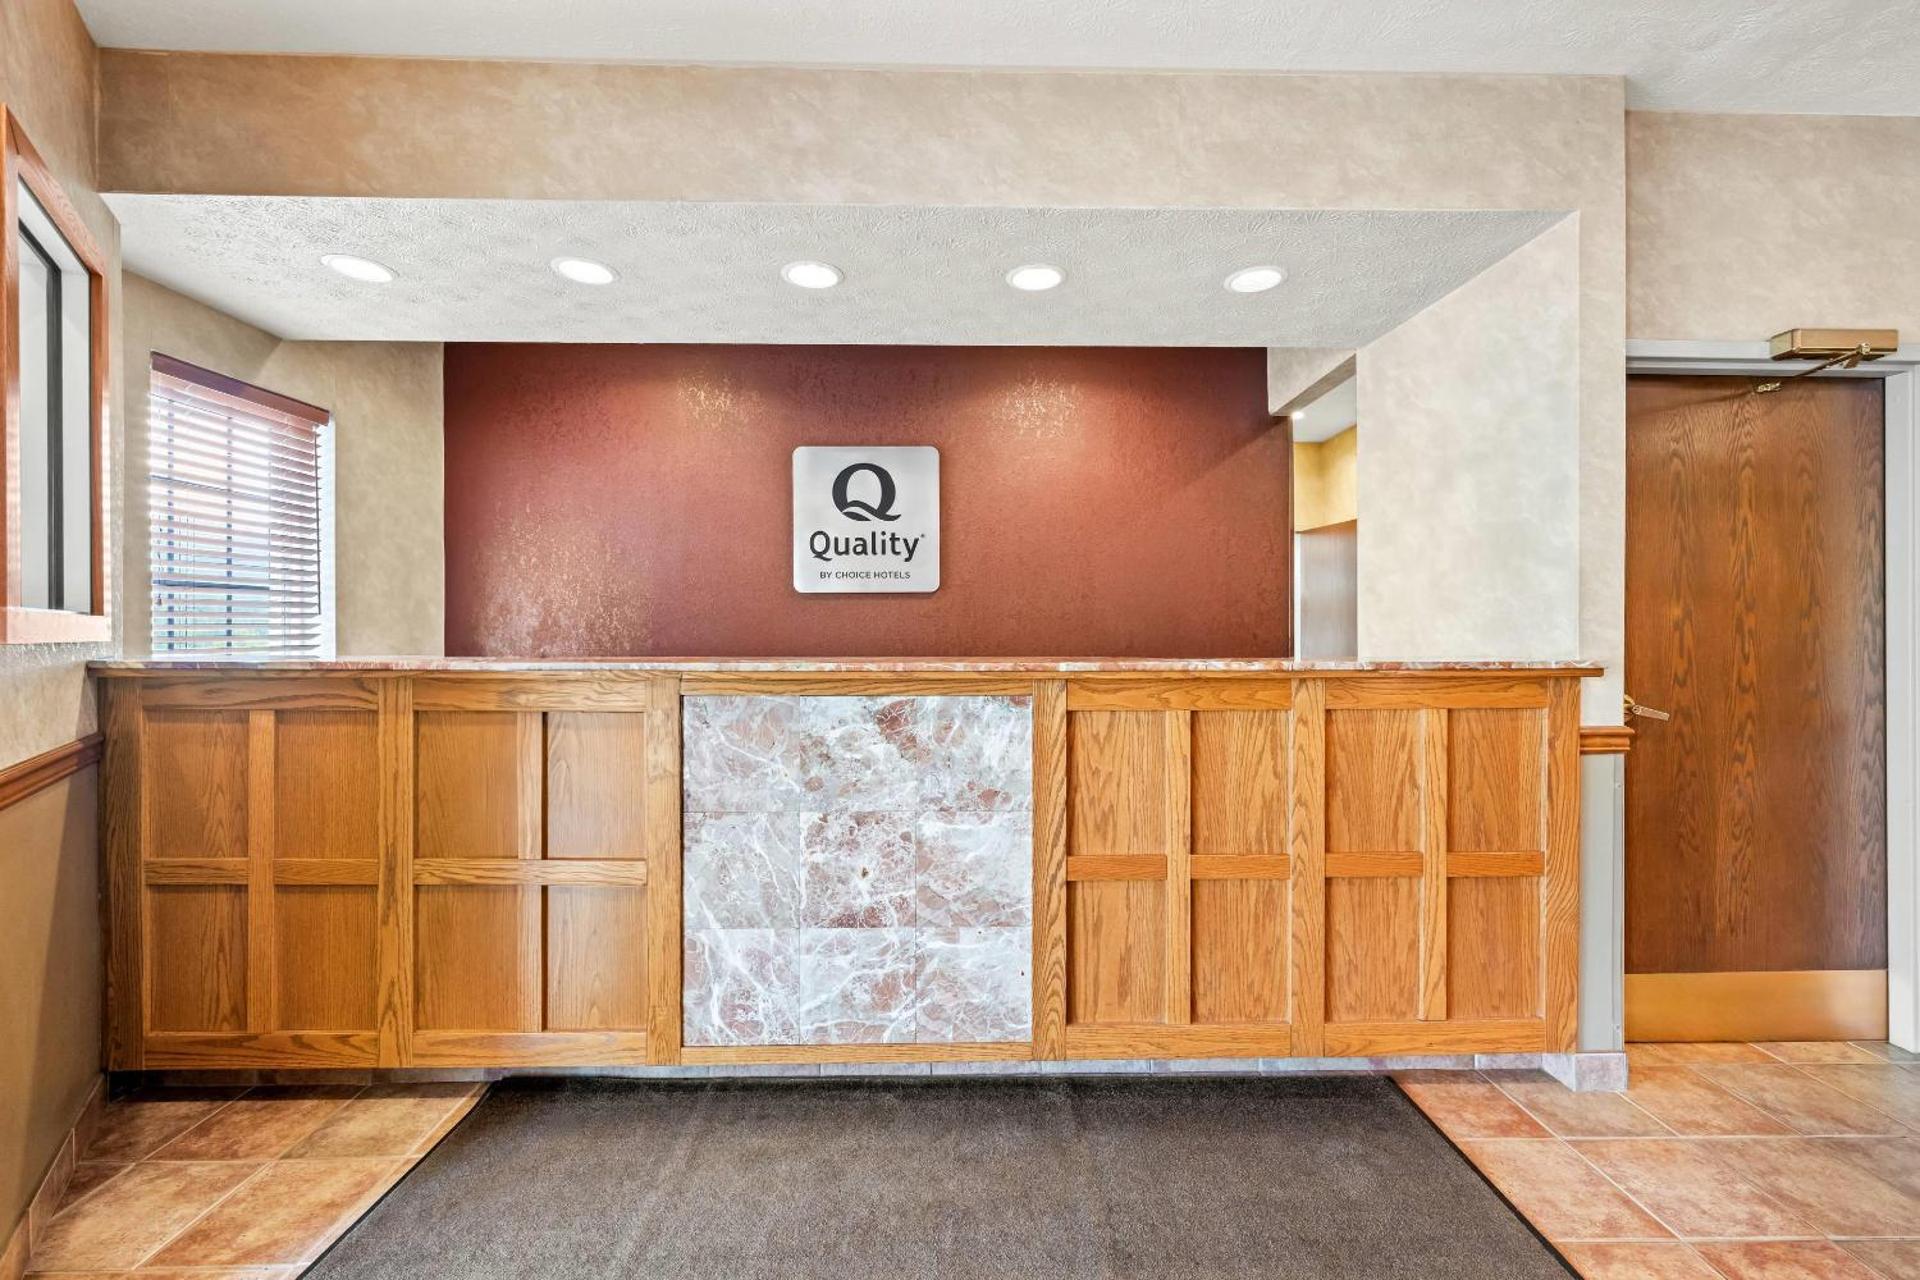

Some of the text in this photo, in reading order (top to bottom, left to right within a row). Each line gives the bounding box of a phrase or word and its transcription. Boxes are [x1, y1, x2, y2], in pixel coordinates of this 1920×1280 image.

[832, 462, 902, 522] Q
[809, 530, 920, 563] Quality
[819, 571, 911, 580] BY CHOICE HOTELS
